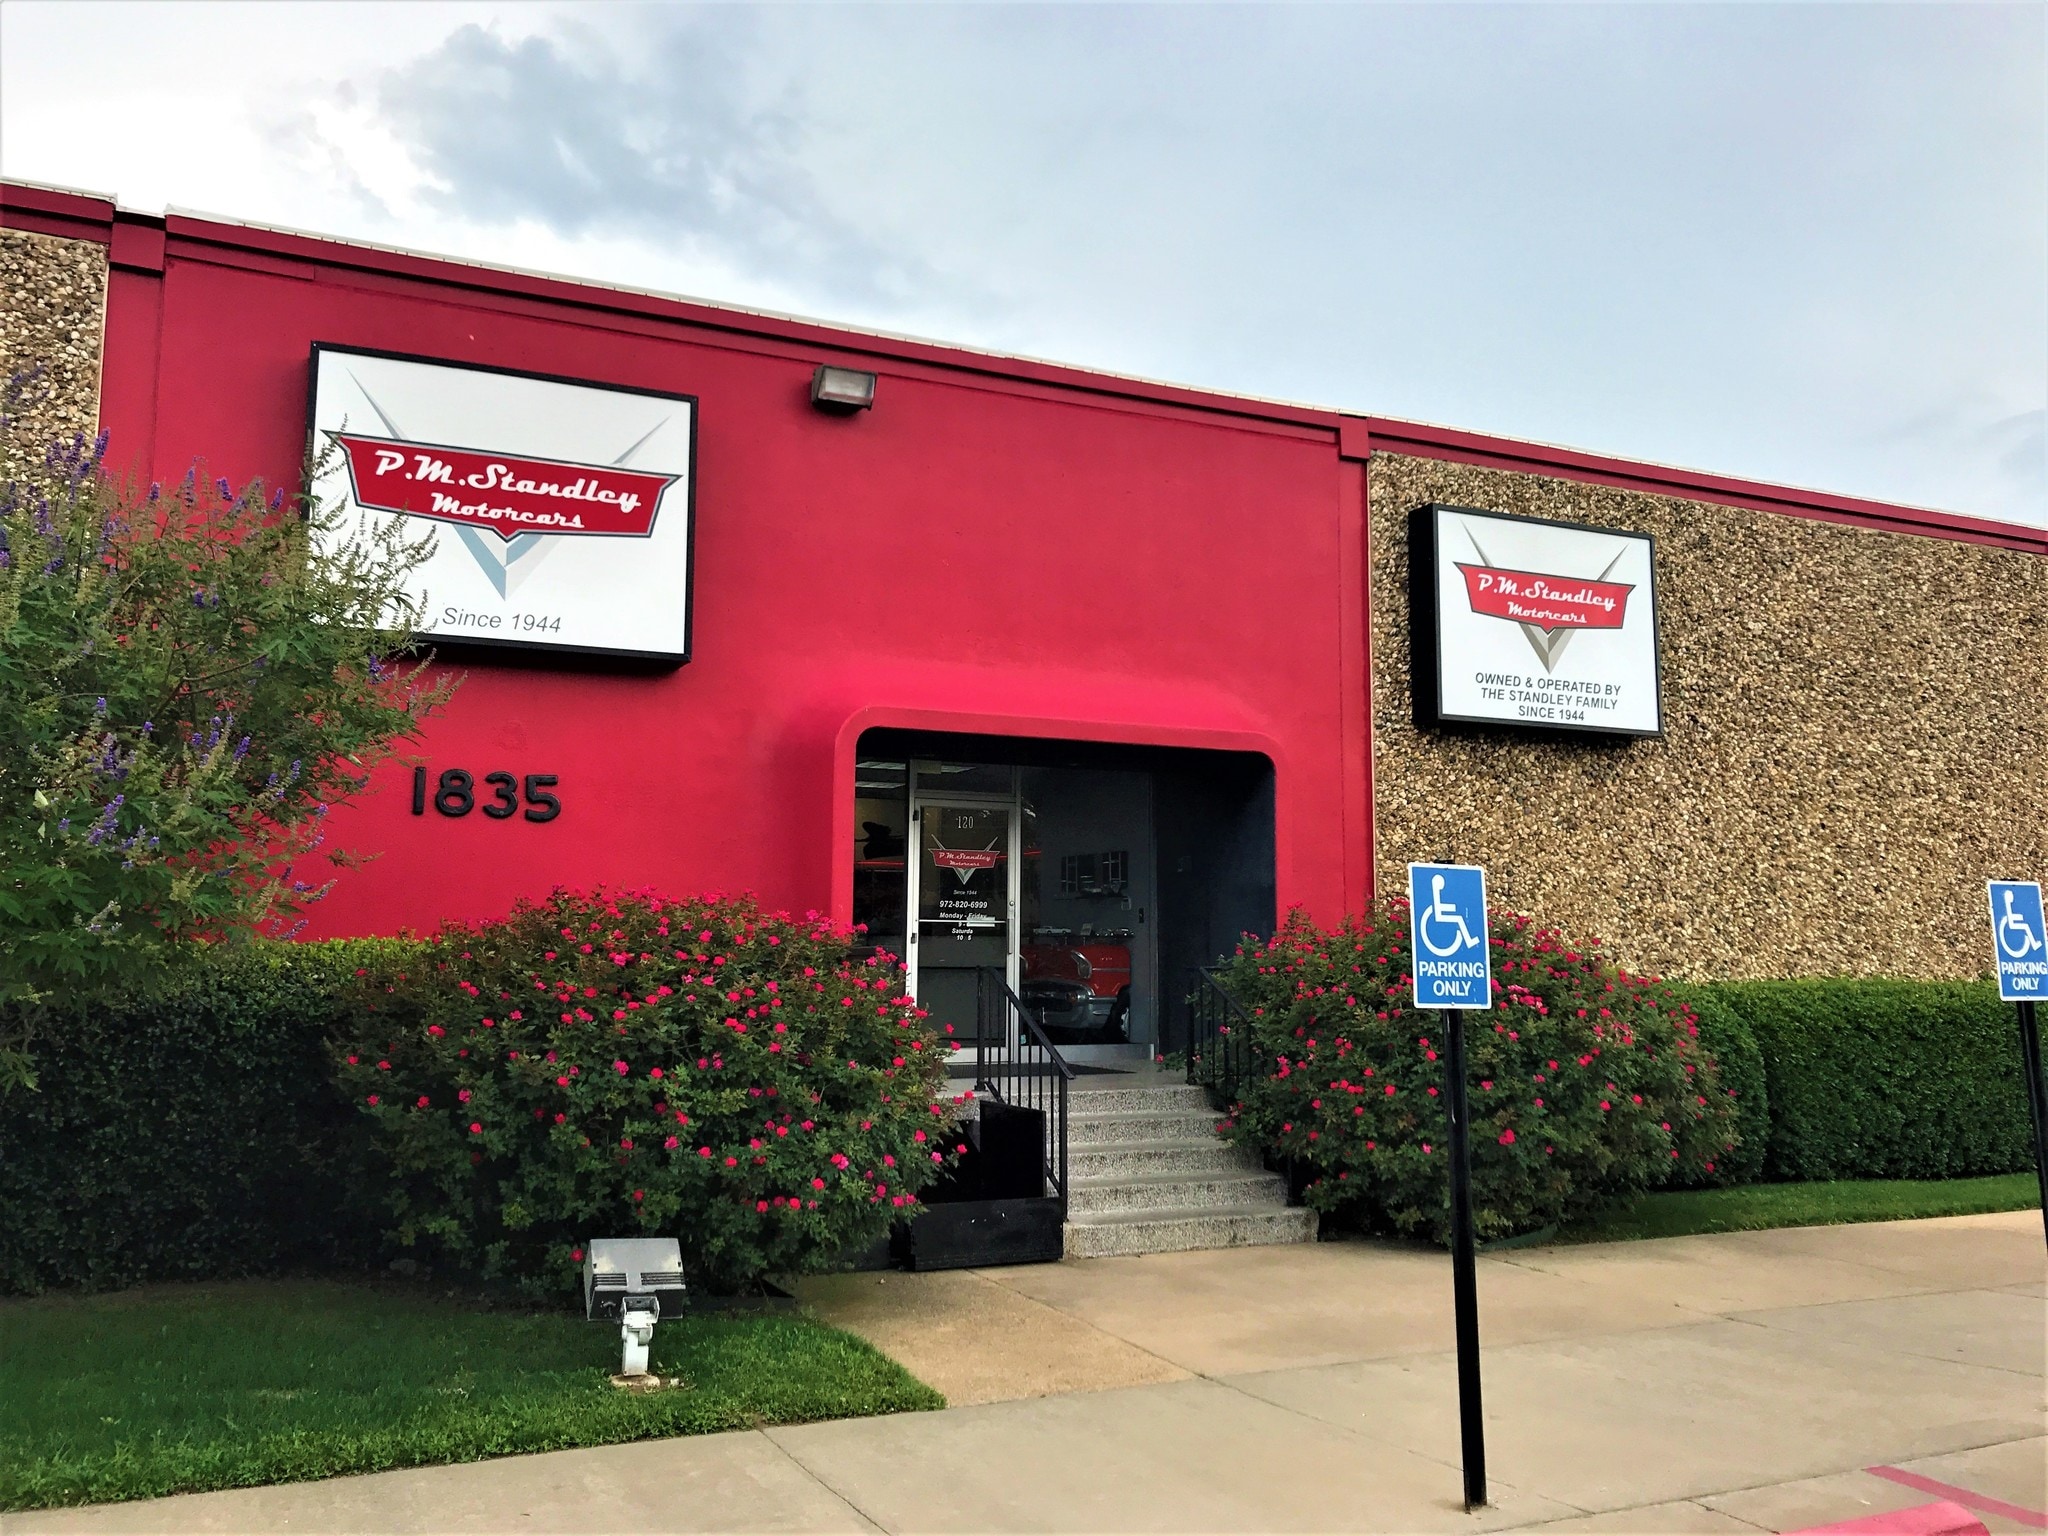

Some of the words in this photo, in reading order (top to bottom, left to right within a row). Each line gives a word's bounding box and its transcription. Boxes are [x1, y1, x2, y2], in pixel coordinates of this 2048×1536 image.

[430, 492, 585, 528] Motorcars
[441, 607, 502, 629] Since
[511, 613, 562, 633] 1944
[1507, 601, 1587, 624] Motorcars
[1475, 672, 1521, 688] OWNED
[1525, 677, 1534, 689] &
[1537, 678, 1602, 695] OPERATED
[1605, 684, 1622, 696] BY
[1481, 687, 1505, 700] THE
[1509, 689, 1573, 706] STANDLEY
[1576, 695, 1618, 710] FAMILY
[1518, 705, 1555, 719] SINCE
[1559, 709, 1585, 721] 1944
[412, 766, 562, 823] 1835
[956, 815, 974, 829] 120
[939, 900, 988, 909] 972-820-6999
[939, 912, 964, 920] Monday
[1419, 961, 1485, 979] PARKING
[2001, 961, 2048, 975] PARKING
[1433, 980, 1472, 997] ONLY
[2012, 977, 2040, 991] ONLY
